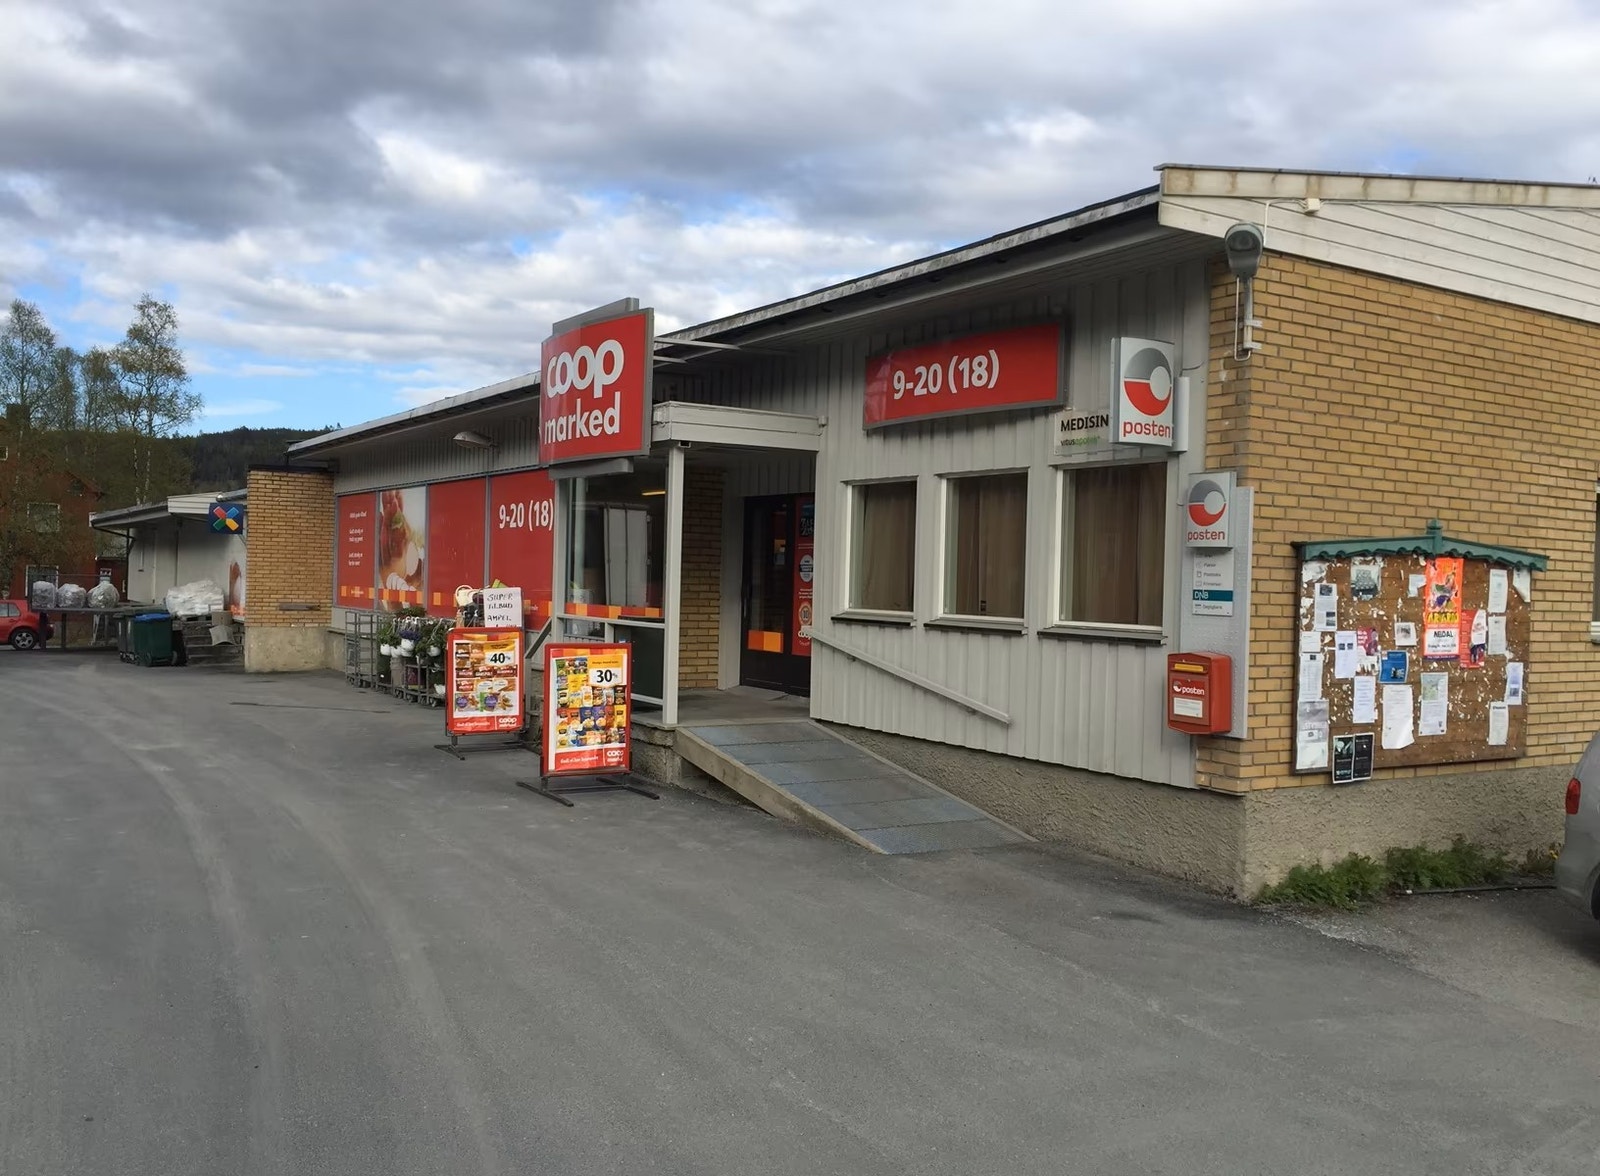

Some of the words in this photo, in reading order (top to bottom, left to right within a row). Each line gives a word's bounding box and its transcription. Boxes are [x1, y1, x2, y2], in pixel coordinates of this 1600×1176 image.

[546, 339, 625, 398] coop
[893, 363, 943, 400] 9-20
[947, 349, 1000, 394] (18)
[544, 391, 621, 444] marked
[1060, 414, 1110, 432] MEDISIN
[1122, 420, 1171, 439] posten
[499, 503, 525, 529] 9-20
[528, 498, 554, 532] (18)
[1187, 529, 1226, 542] posten
[1194, 591, 1209, 600] DNB
[1181, 686, 1205, 695] posten
